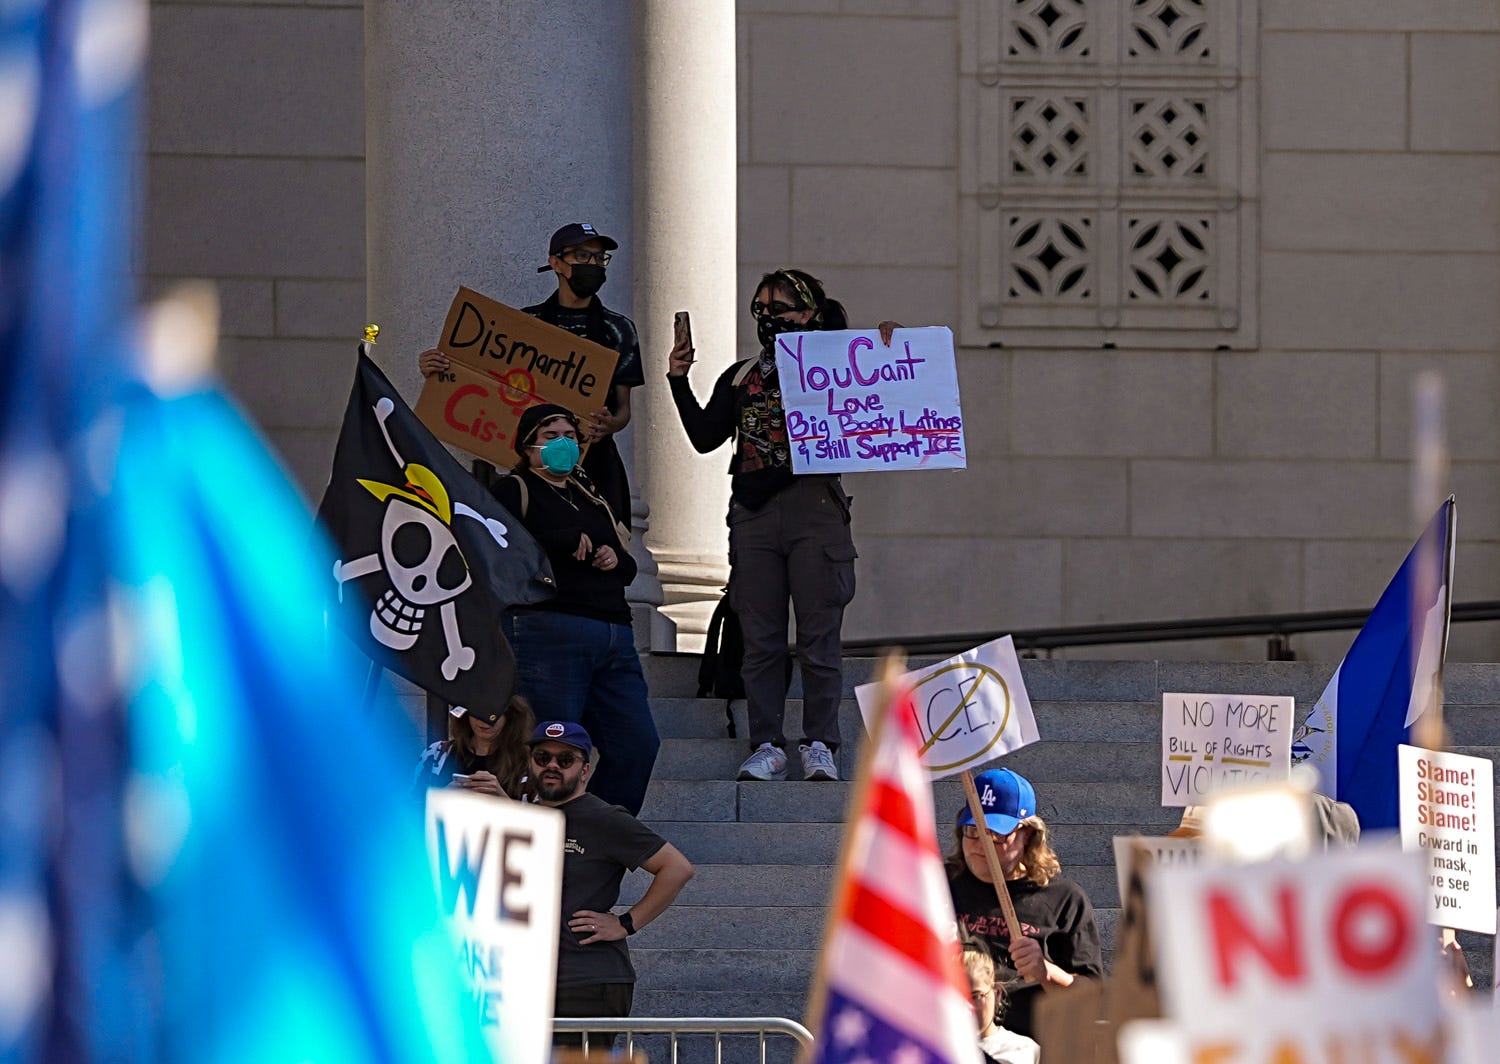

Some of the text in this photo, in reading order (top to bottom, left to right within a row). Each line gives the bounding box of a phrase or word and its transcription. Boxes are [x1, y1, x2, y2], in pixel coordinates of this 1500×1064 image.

[449, 301, 596, 398] Dismantle
[778, 335, 926, 393] You Cant
[827, 388, 884, 415] Love
[444, 384, 518, 450] Cis-
[787, 411, 830, 442] Big
[837, 414, 894, 438] Booty
[815, 438, 851, 459] Still
[856, 434, 923, 463] Support
[922, 436, 962, 455] ICE
[1182, 700, 1280, 732] NO MORE
[1169, 737, 1273, 759] BILL OF RIGHTS
[981, 784, 996, 807] LA
[1467, 839, 1478, 855] in
[435, 818, 536, 930] WE
[1433, 856, 1472, 875] mask,
[1448, 878, 1470, 892] see
[1434, 893, 1462, 909] you.
[1202, 878, 1418, 992] NO
